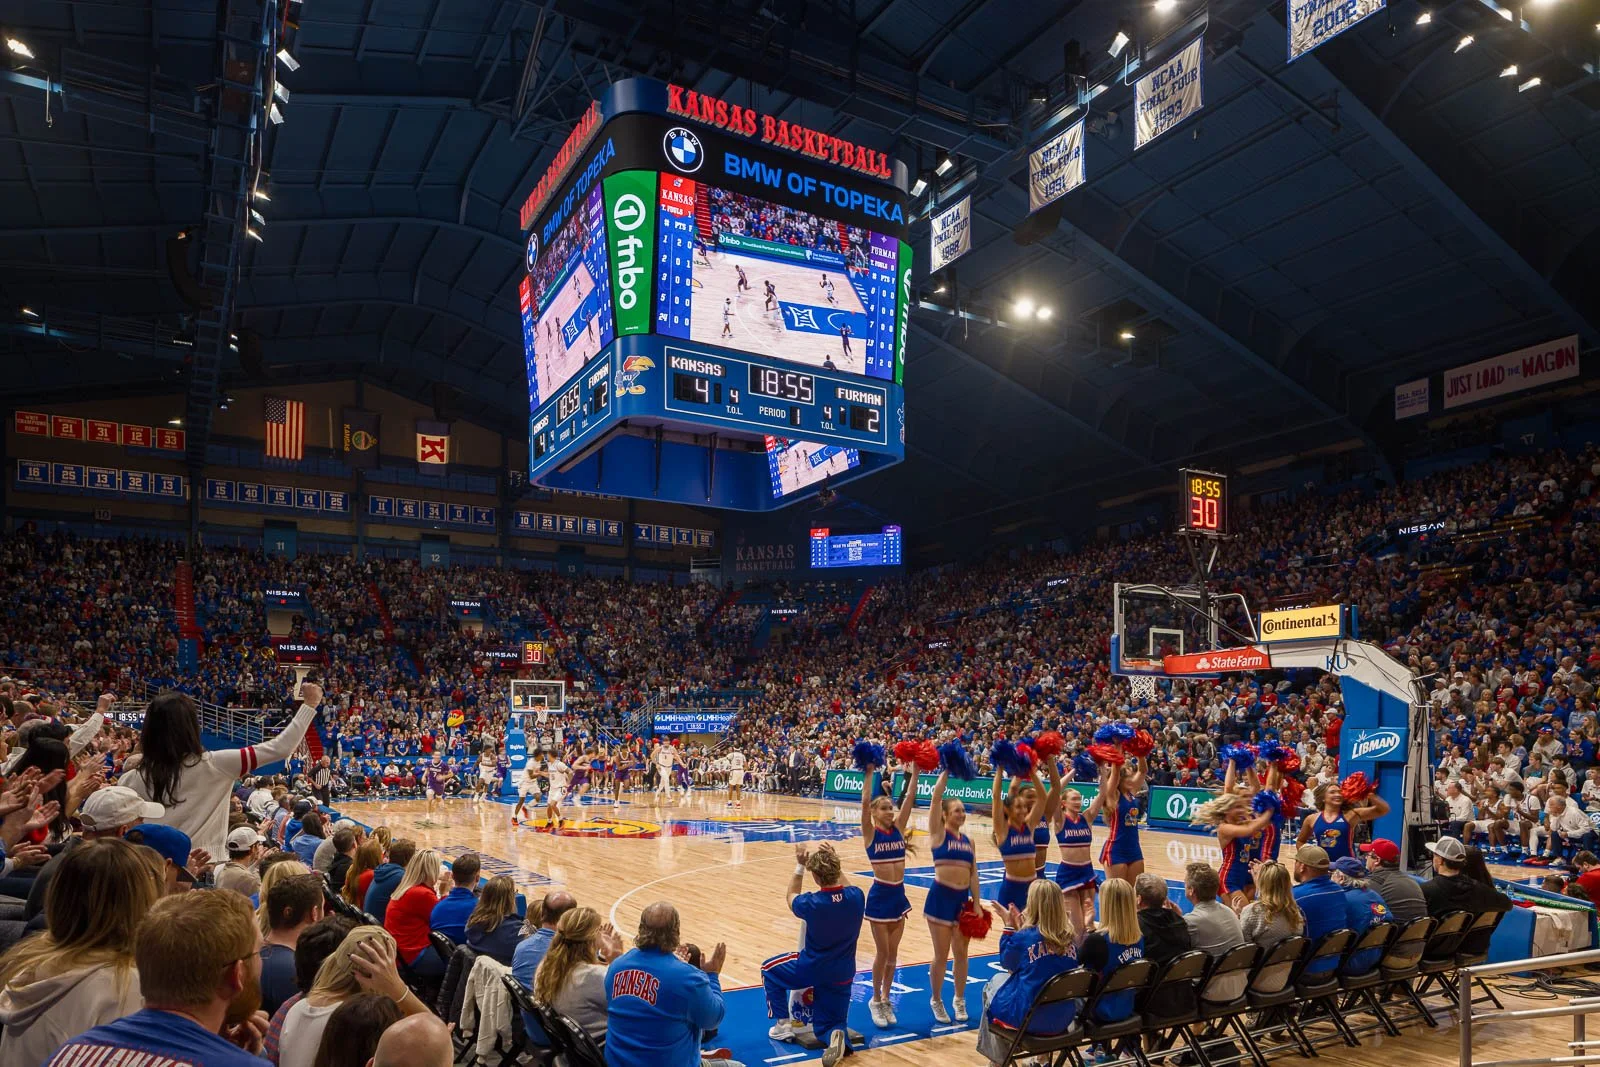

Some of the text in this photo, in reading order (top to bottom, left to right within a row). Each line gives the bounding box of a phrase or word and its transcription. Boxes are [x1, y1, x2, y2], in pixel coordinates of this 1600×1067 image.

[1312, 0, 1357, 39] 2002
[1152, 59, 1184, 92] NCAA
[1140, 67, 1198, 115] FINAL FOUR
[1153, 98, 1183, 128] 1993
[666, 83, 892, 179] KANSAS BASKETBALL
[1042, 139, 1068, 165] NCAA
[1032, 163, 1056, 186] FINAL
[543, 203, 562, 245] BMW
[563, 188, 575, 217] OF
[576, 137, 615, 201] TOPEKA
[724, 152, 904, 225] BMW OF TOPEKA
[662, 189, 694, 206] KANSAS
[675, 221, 686, 231] PTS
[941, 208, 960, 230] NCAA
[934, 217, 968, 247] FINAL FOUR
[871, 246, 896, 260] FURMAN
[617, 234, 645, 310] fnbo
[671, 355, 722, 377] KANSAS
[1446, 374, 1473, 398] JUST
[1476, 366, 1504, 390] LOAD
[1522, 345, 1576, 378] WAGON
[695, 378, 709, 403] 4
[760, 369, 812, 401] 18:55
[601, 381, 608, 407] 2
[729, 389, 739, 403] 4
[837, 388, 882, 406] FURMAN
[758, 406, 786, 419] PERIOD
[796, 409, 801, 425] 1
[823, 405, 832, 420] 4
[868, 408, 880, 433] 2
[62, 423, 73, 434] 21
[97, 427, 108, 437] 31
[131, 432, 142, 441] 12
[164, 435, 177, 445] 33
[420, 436, 445, 462] K
[61, 470, 76, 480] 25
[96, 474, 108, 484] 13
[129, 478, 142, 487] 32
[163, 481, 174, 490] 13
[1191, 479, 1221, 498] 18:55
[275, 492, 285, 501] 15
[304, 495, 313, 504] 14
[330, 497, 343, 506] 25
[403, 505, 414, 513] 45
[429, 507, 439, 515] 34
[1191, 496, 1218, 527] 30
[1398, 522, 1446, 535] NISSAN
[431, 554, 440, 562] 12
[736, 544, 795, 561] KANSAS
[736, 560, 796, 572] BASKETBALL
[266, 589, 300, 597] NISSAN
[1262, 615, 1327, 635] Continental
[527, 650, 540, 662] 30
[1326, 654, 1349, 671] KU
[118, 713, 137, 721] 18:55
[1351, 737, 1395, 760] LIBMAN
[844, 775, 863, 791] fnbo
[965, 787, 984, 800] Bank
[831, 893, 843, 903] KU
[611, 969, 660, 1006] KANSAS
